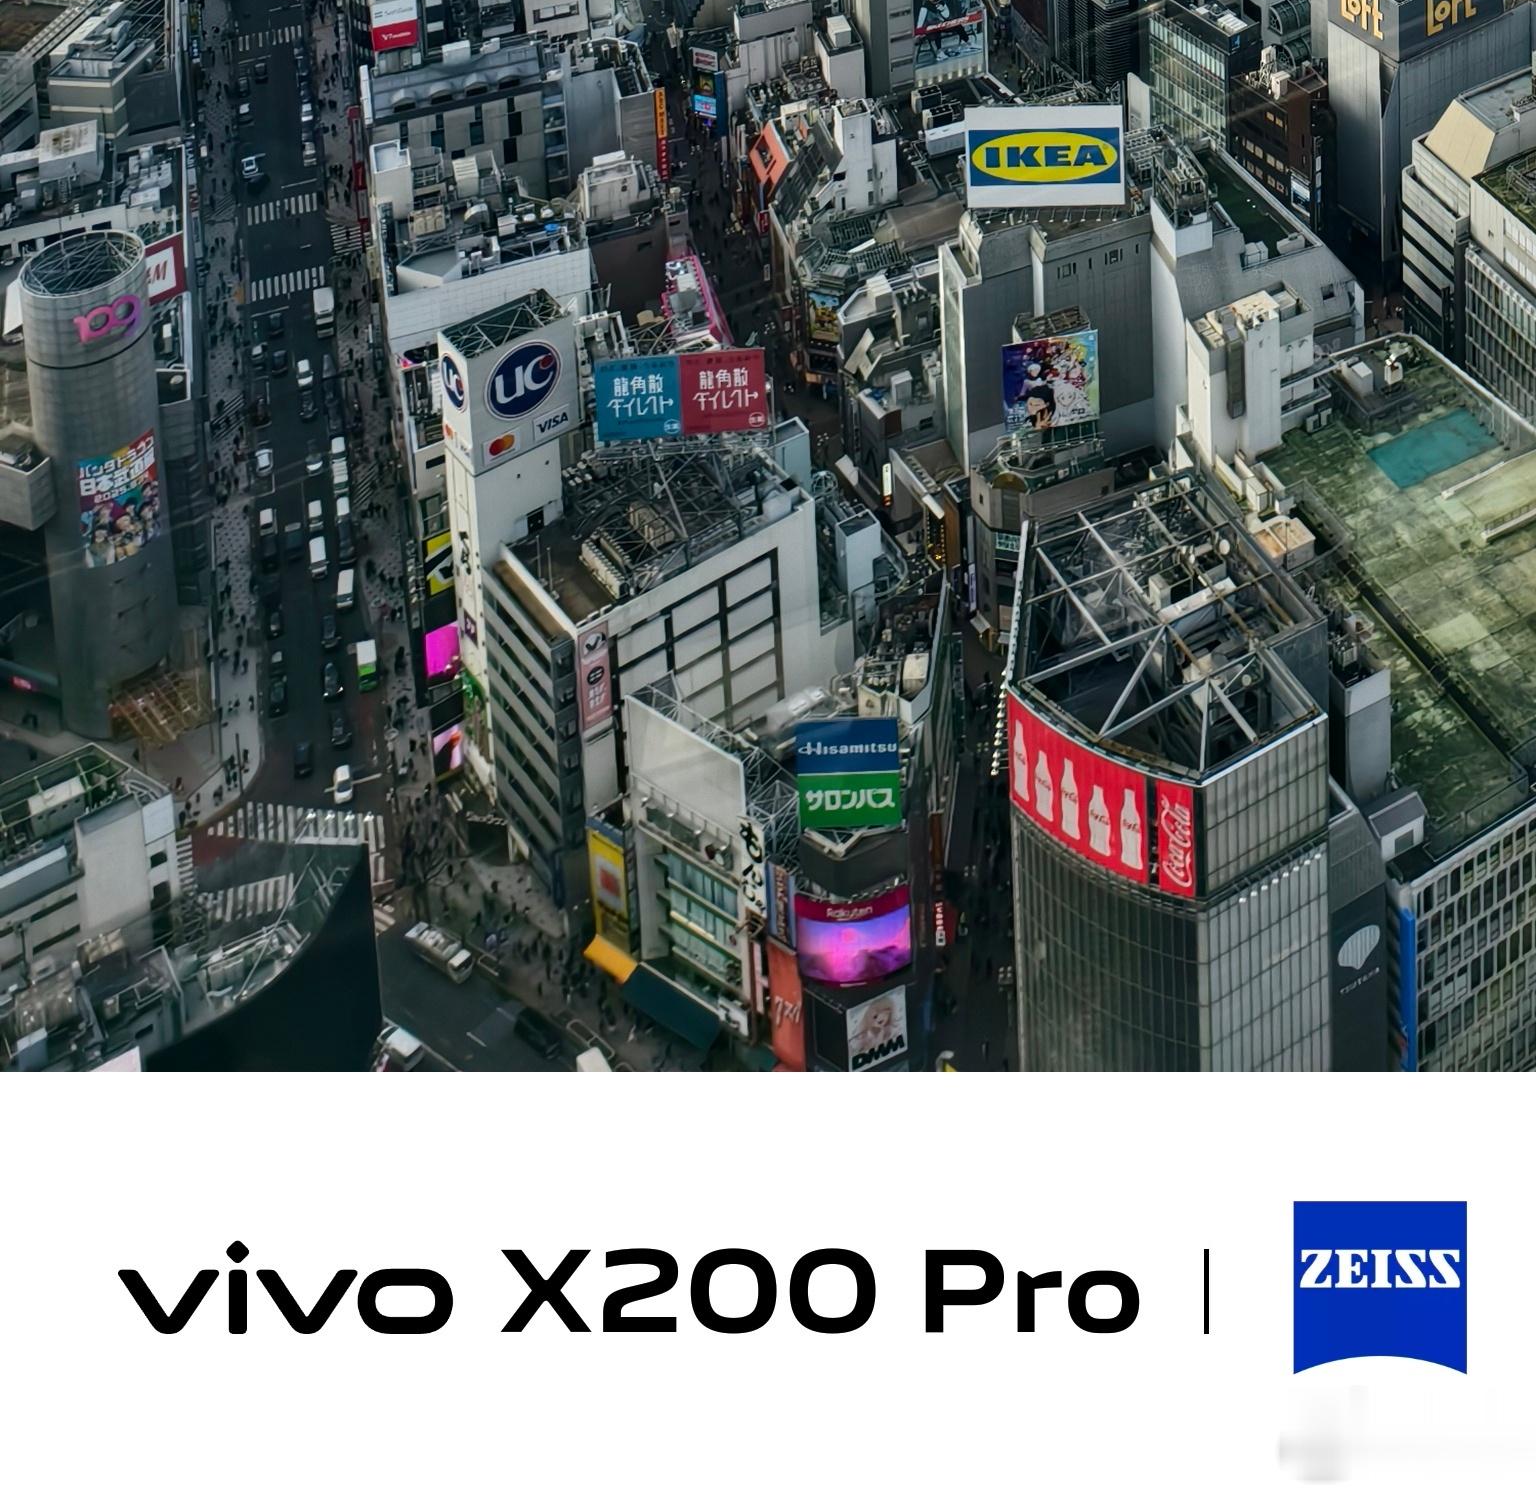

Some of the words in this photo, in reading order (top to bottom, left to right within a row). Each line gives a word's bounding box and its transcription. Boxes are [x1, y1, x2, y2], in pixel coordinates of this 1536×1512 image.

[985, 144, 1108, 178] IKEA
[73, 294, 141, 344] 109
[494, 352, 555, 405] UC
[613, 373, 664, 397] 龍角散
[699, 367, 749, 390] 龍角散
[537, 412, 569, 433] VISA
[798, 742, 897, 755] Hisamitsu
[805, 788, 896, 812] サロンパス
[826, 905, 873, 922] Rakuten
[851, 1033, 905, 1070] DMM
